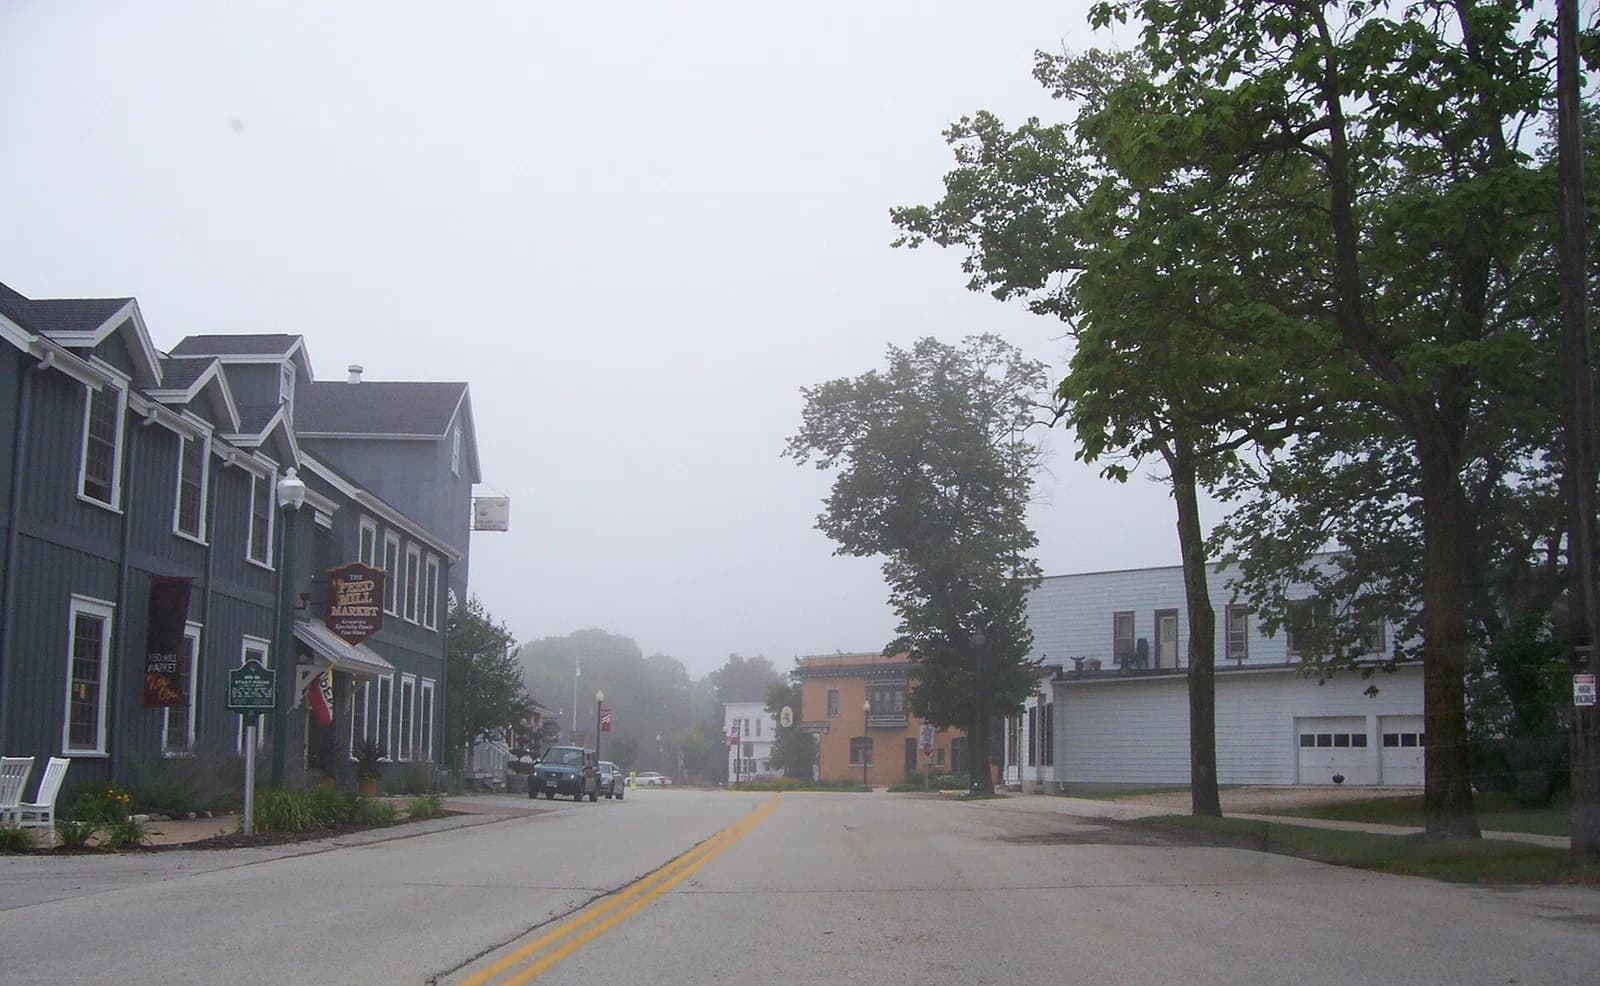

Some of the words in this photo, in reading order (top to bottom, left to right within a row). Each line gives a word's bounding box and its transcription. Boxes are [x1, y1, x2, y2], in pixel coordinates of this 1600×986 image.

[337, 580, 375, 593] FEED
[337, 592, 372, 605] MILL
[331, 606, 379, 617] MARKET
